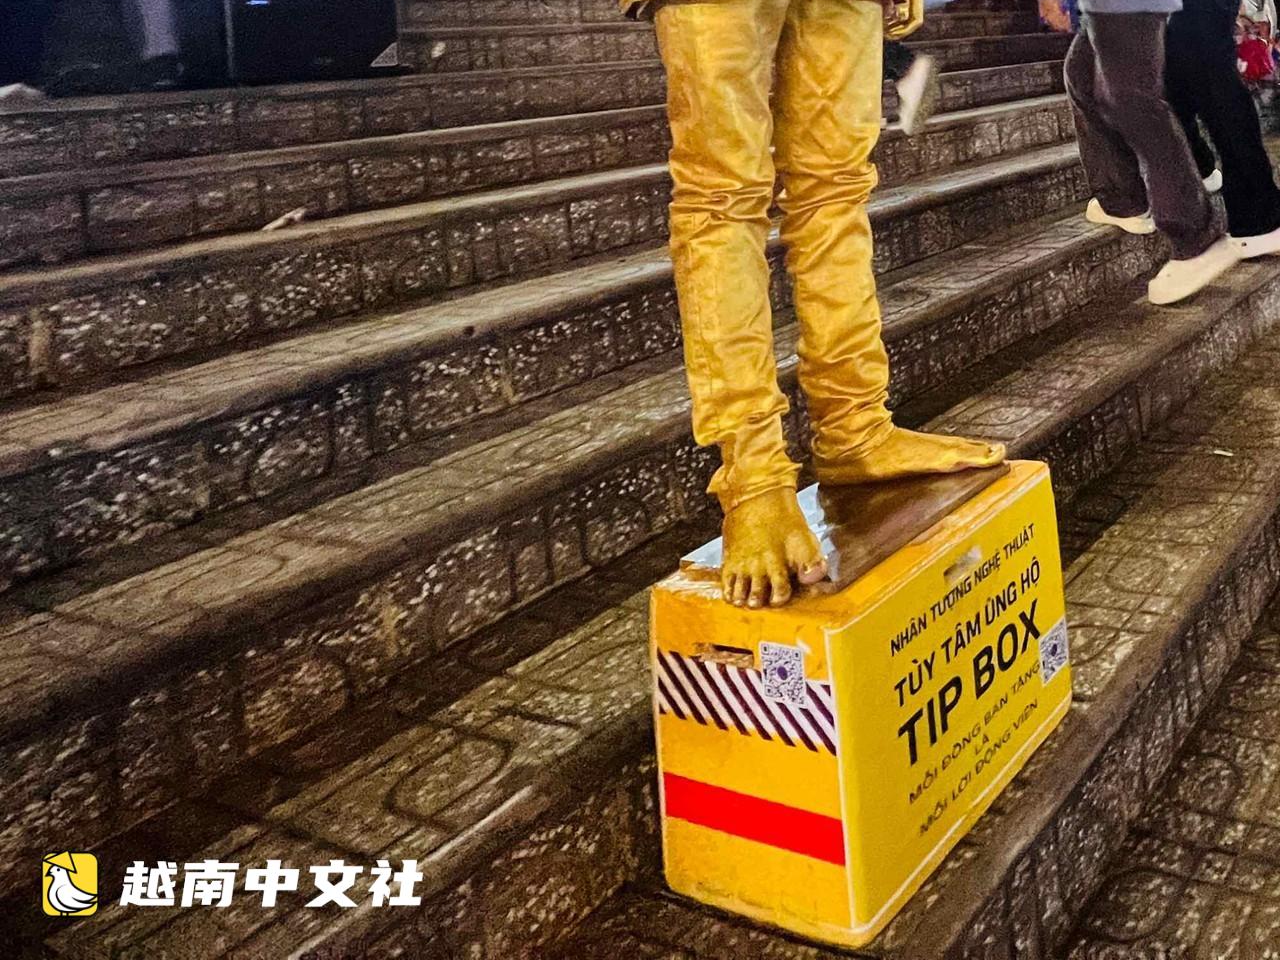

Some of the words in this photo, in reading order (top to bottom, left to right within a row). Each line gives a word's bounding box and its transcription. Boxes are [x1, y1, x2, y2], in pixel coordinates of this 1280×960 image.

[890, 613, 927, 657] NHÂN
[974, 550, 1001, 586] NGHỆ
[1003, 523, 1035, 560] THUẬT
[894, 651, 935, 708] TÙY
[941, 611, 981, 664] TÂM
[1020, 556, 1040, 594] HỘ
[897, 675, 963, 767] TIP
[973, 598, 1041, 701] BOX
